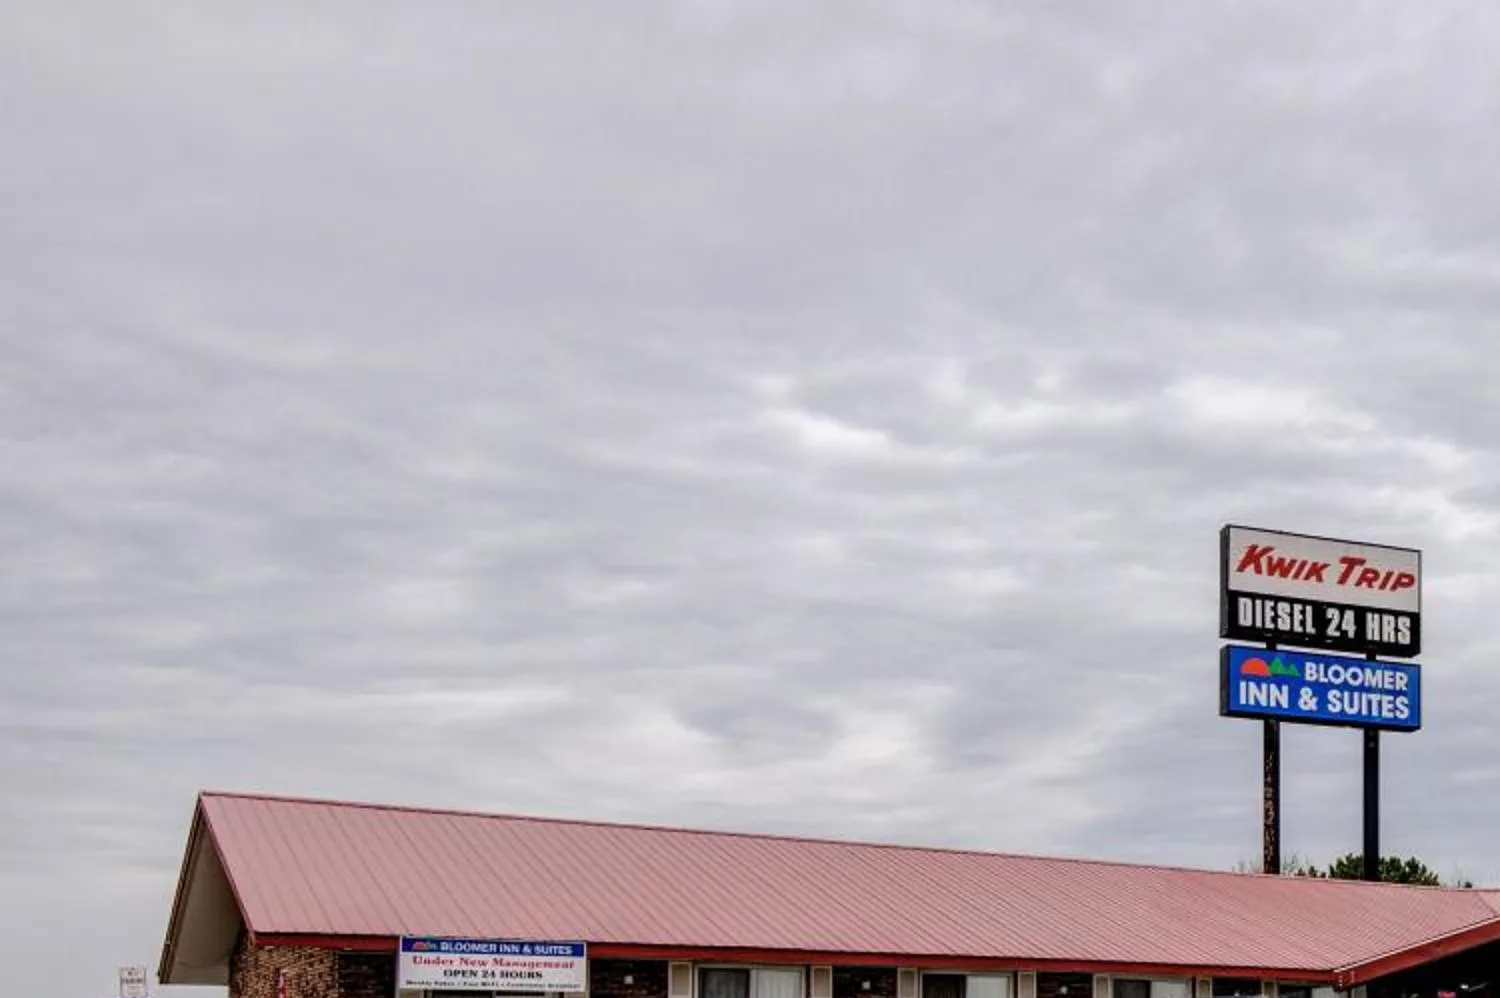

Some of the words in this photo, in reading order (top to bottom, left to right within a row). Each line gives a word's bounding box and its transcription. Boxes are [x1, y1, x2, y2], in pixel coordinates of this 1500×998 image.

[1237, 597, 1316, 635] DIESEL
[1325, 608, 1356, 639] 24
[1366, 612, 1411, 645] HRS
[1304, 662, 1408, 691] BLOOMER
[1239, 681, 1289, 708] INN
[1298, 687, 1318, 711] &
[1327, 690, 1409, 719] SUITES
[440, 942, 497, 953] BLOOMER
[499, 943, 520, 954] INN
[522, 945, 531, 954] &
[534, 945, 573, 955] SUITES
[413, 956, 453, 965] Under
[459, 957, 488, 966] New
[492, 958, 575, 969] Management
[443, 969, 478, 979] OPEN
[482, 970, 496, 979] 24
[500, 970, 543, 980] HOURS
